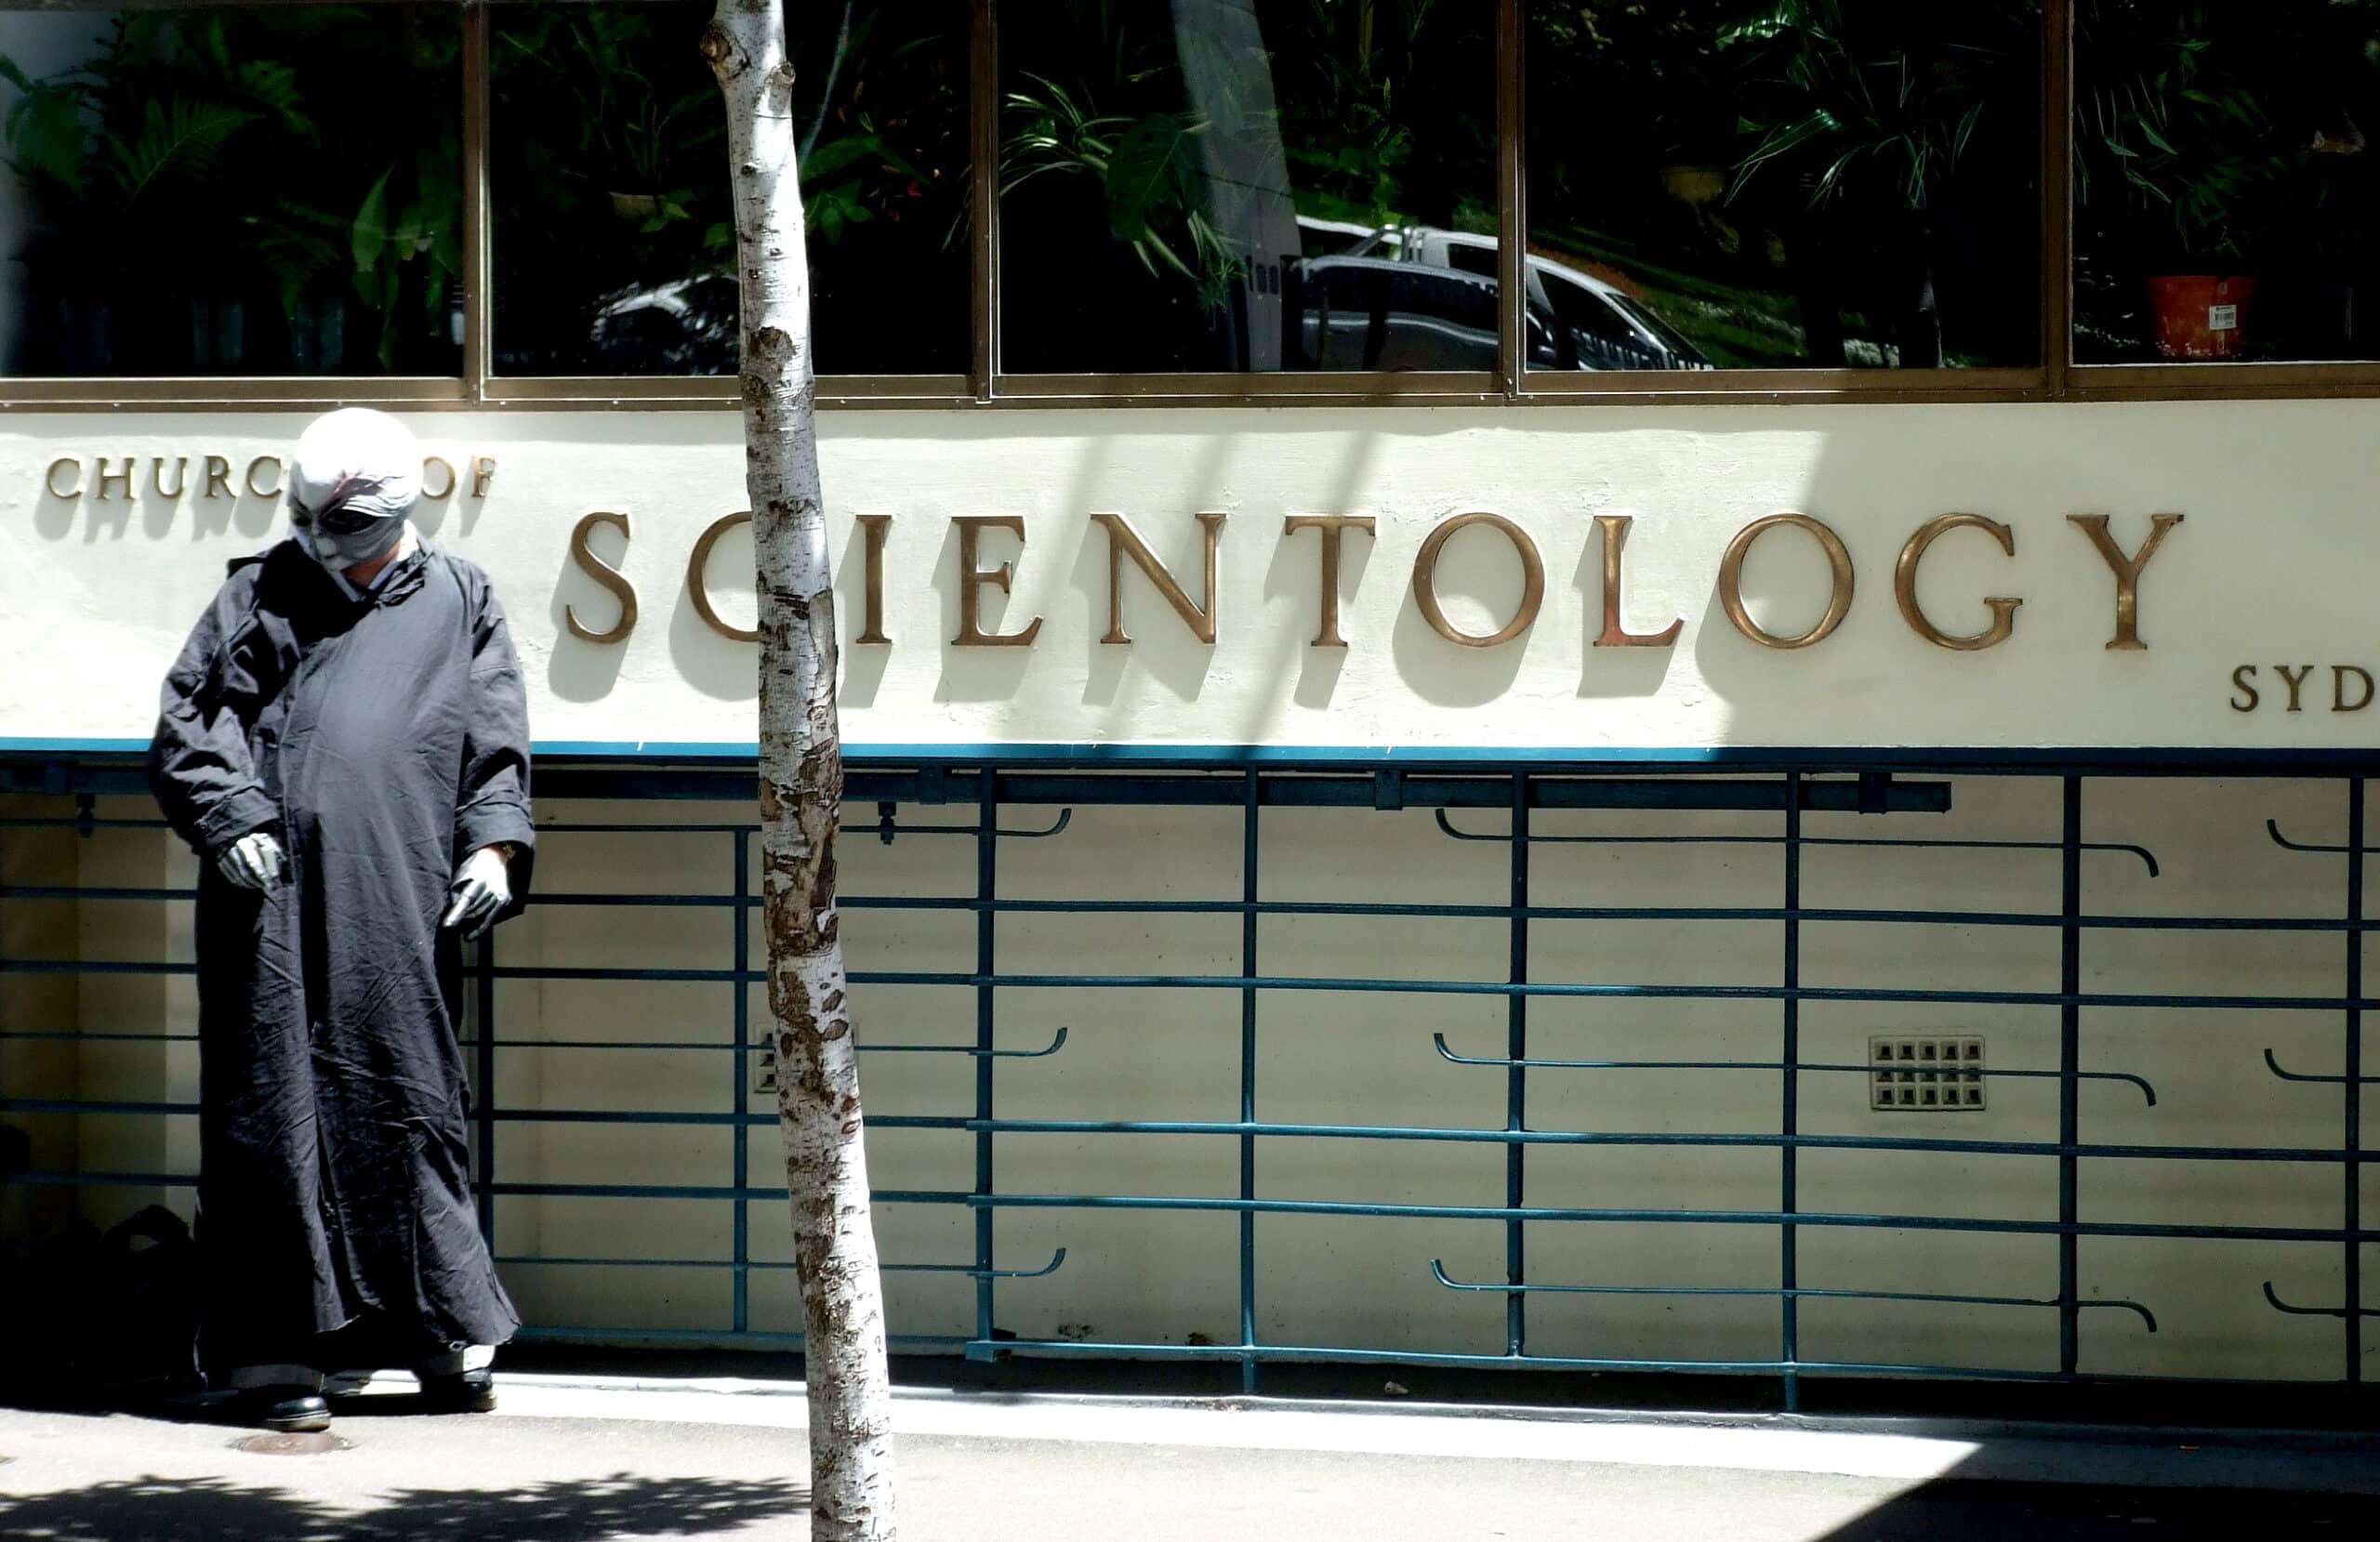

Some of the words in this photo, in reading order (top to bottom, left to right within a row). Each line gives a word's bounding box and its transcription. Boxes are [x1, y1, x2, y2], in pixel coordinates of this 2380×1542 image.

[46, 455, 283, 499] CHURC
[420, 455, 496, 500] OF
[566, 510, 2185, 651] SCIENTOLOGY
[2230, 664, 2375, 713] SYD
